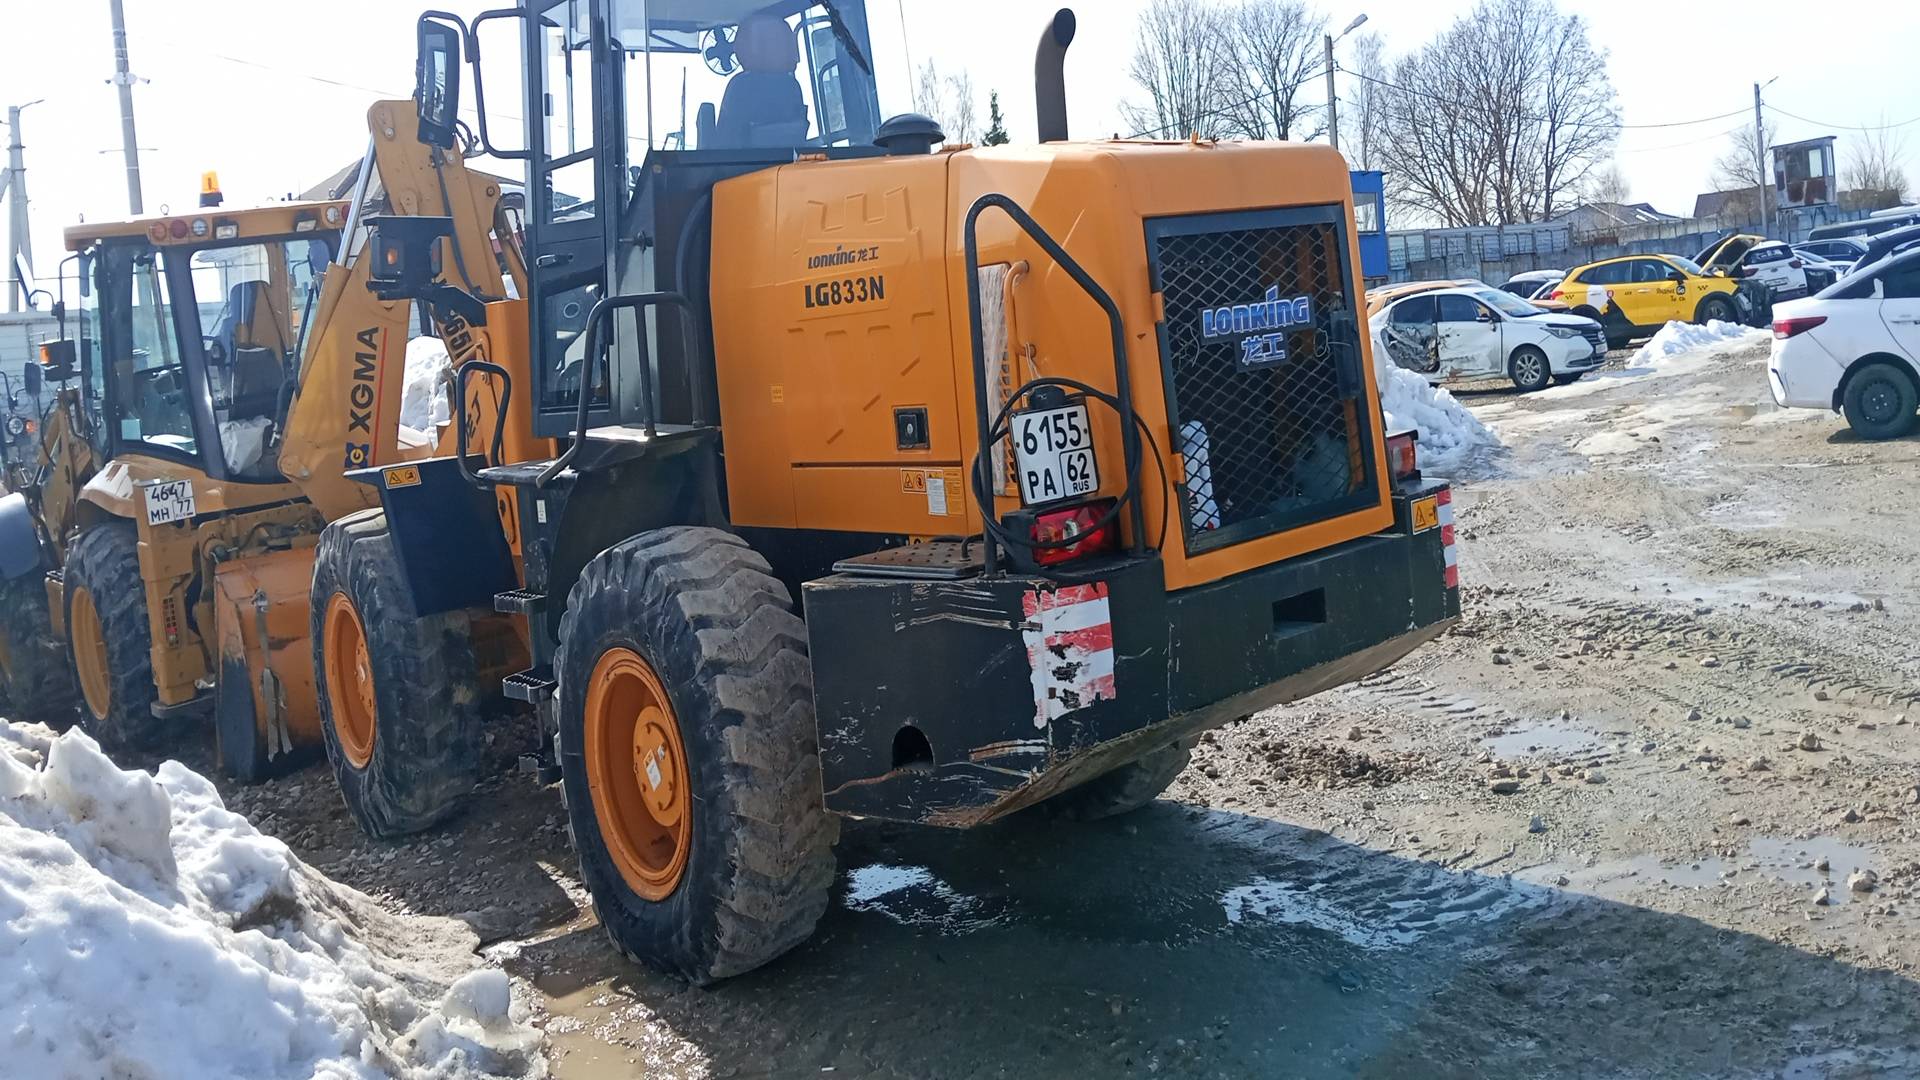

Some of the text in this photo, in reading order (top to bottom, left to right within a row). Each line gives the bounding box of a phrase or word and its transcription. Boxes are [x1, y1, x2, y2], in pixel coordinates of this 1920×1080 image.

[804, 275, 884, 308] LG833N
[1240, 332, 1286, 366] 龙工
[349, 326, 379, 434] XGMA
[1023, 411, 1082, 455] 6155
[1067, 452, 1090, 483] 62
[151, 481, 186, 502] 4647
[1072, 480, 1090, 493] RUS
[177, 499, 191, 513] 77
